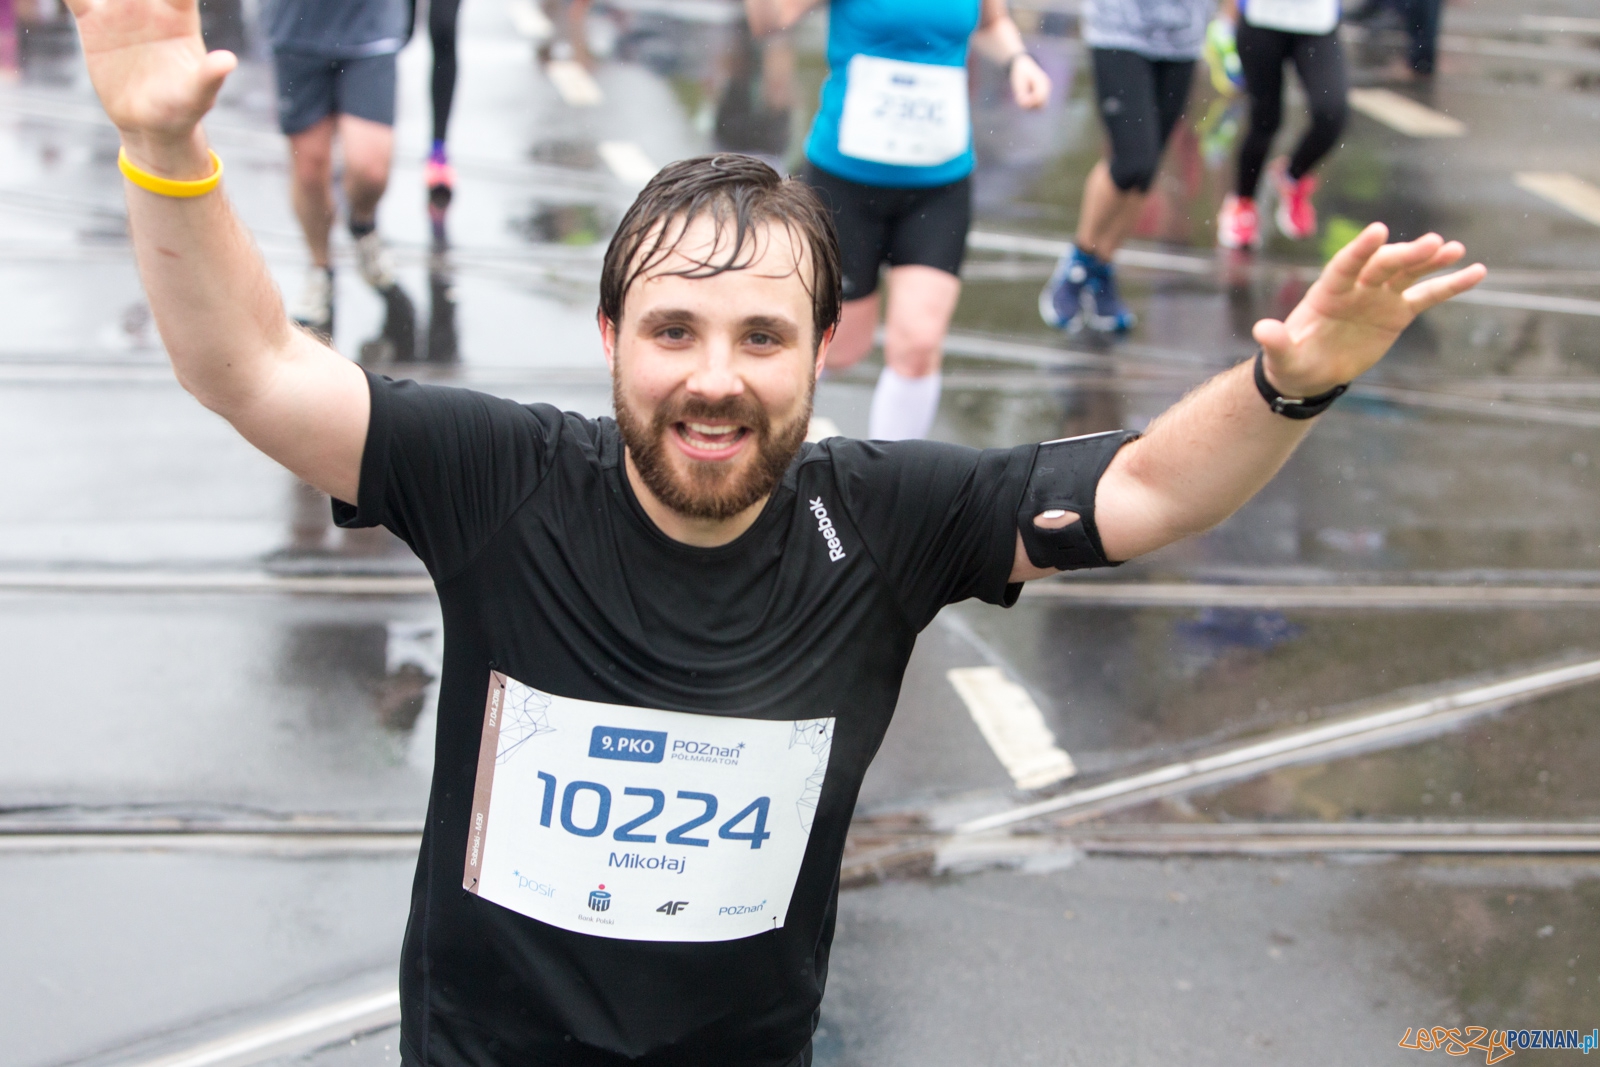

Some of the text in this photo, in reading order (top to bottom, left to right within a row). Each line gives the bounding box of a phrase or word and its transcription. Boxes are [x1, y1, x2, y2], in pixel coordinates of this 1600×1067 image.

[809, 495, 846, 562] Reebok
[489, 688, 500, 727] 17.04.2016
[601, 735, 655, 754] 9. PKO
[671, 753, 739, 766] PÓŁMARATON
[537, 770, 771, 850] 10224
[475, 812, 484, 831] M30
[608, 852, 686, 874] Mikołaj
[518, 875, 556, 898] posir
[656, 900, 689, 916] 4F
[578, 914, 615, 925] Bank Polski
